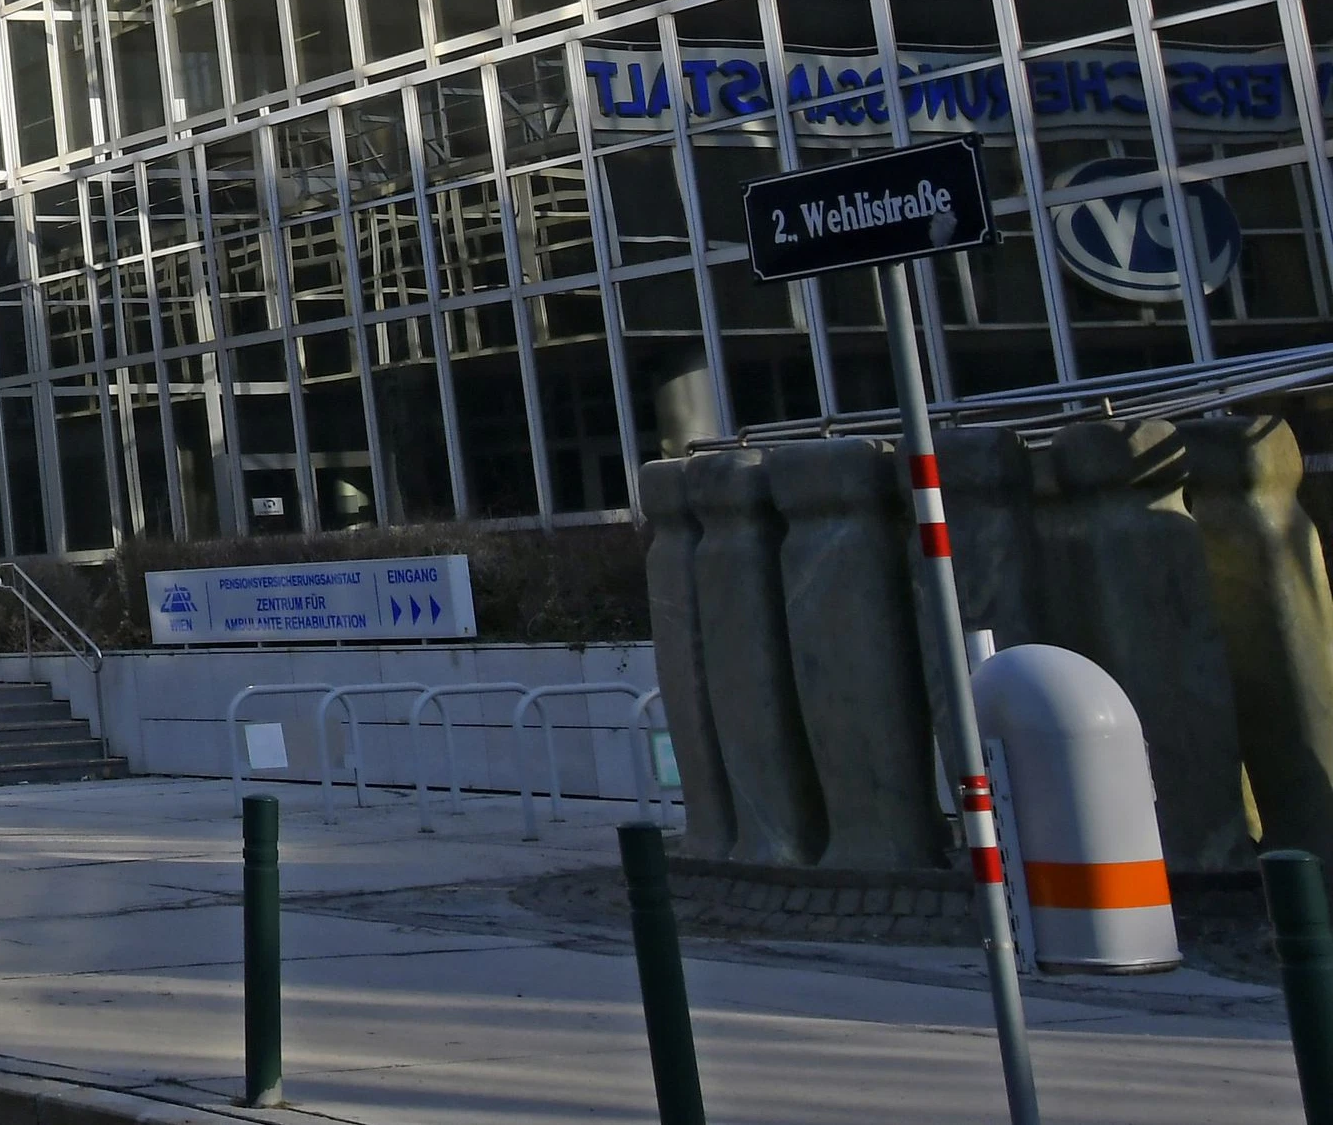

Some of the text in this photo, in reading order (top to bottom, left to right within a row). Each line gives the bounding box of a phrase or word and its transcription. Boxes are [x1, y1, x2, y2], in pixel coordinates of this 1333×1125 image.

[800, 179, 952, 239] Wehlistraße
[219, 572, 361, 590] PENSIONSVERSICHERUNGSANSTALT
[387, 568, 438, 584] EINGANG
[256, 593, 326, 612] ZENTRUM FÜR
[224, 614, 367, 631] AMBULANTE REHABILITATION
